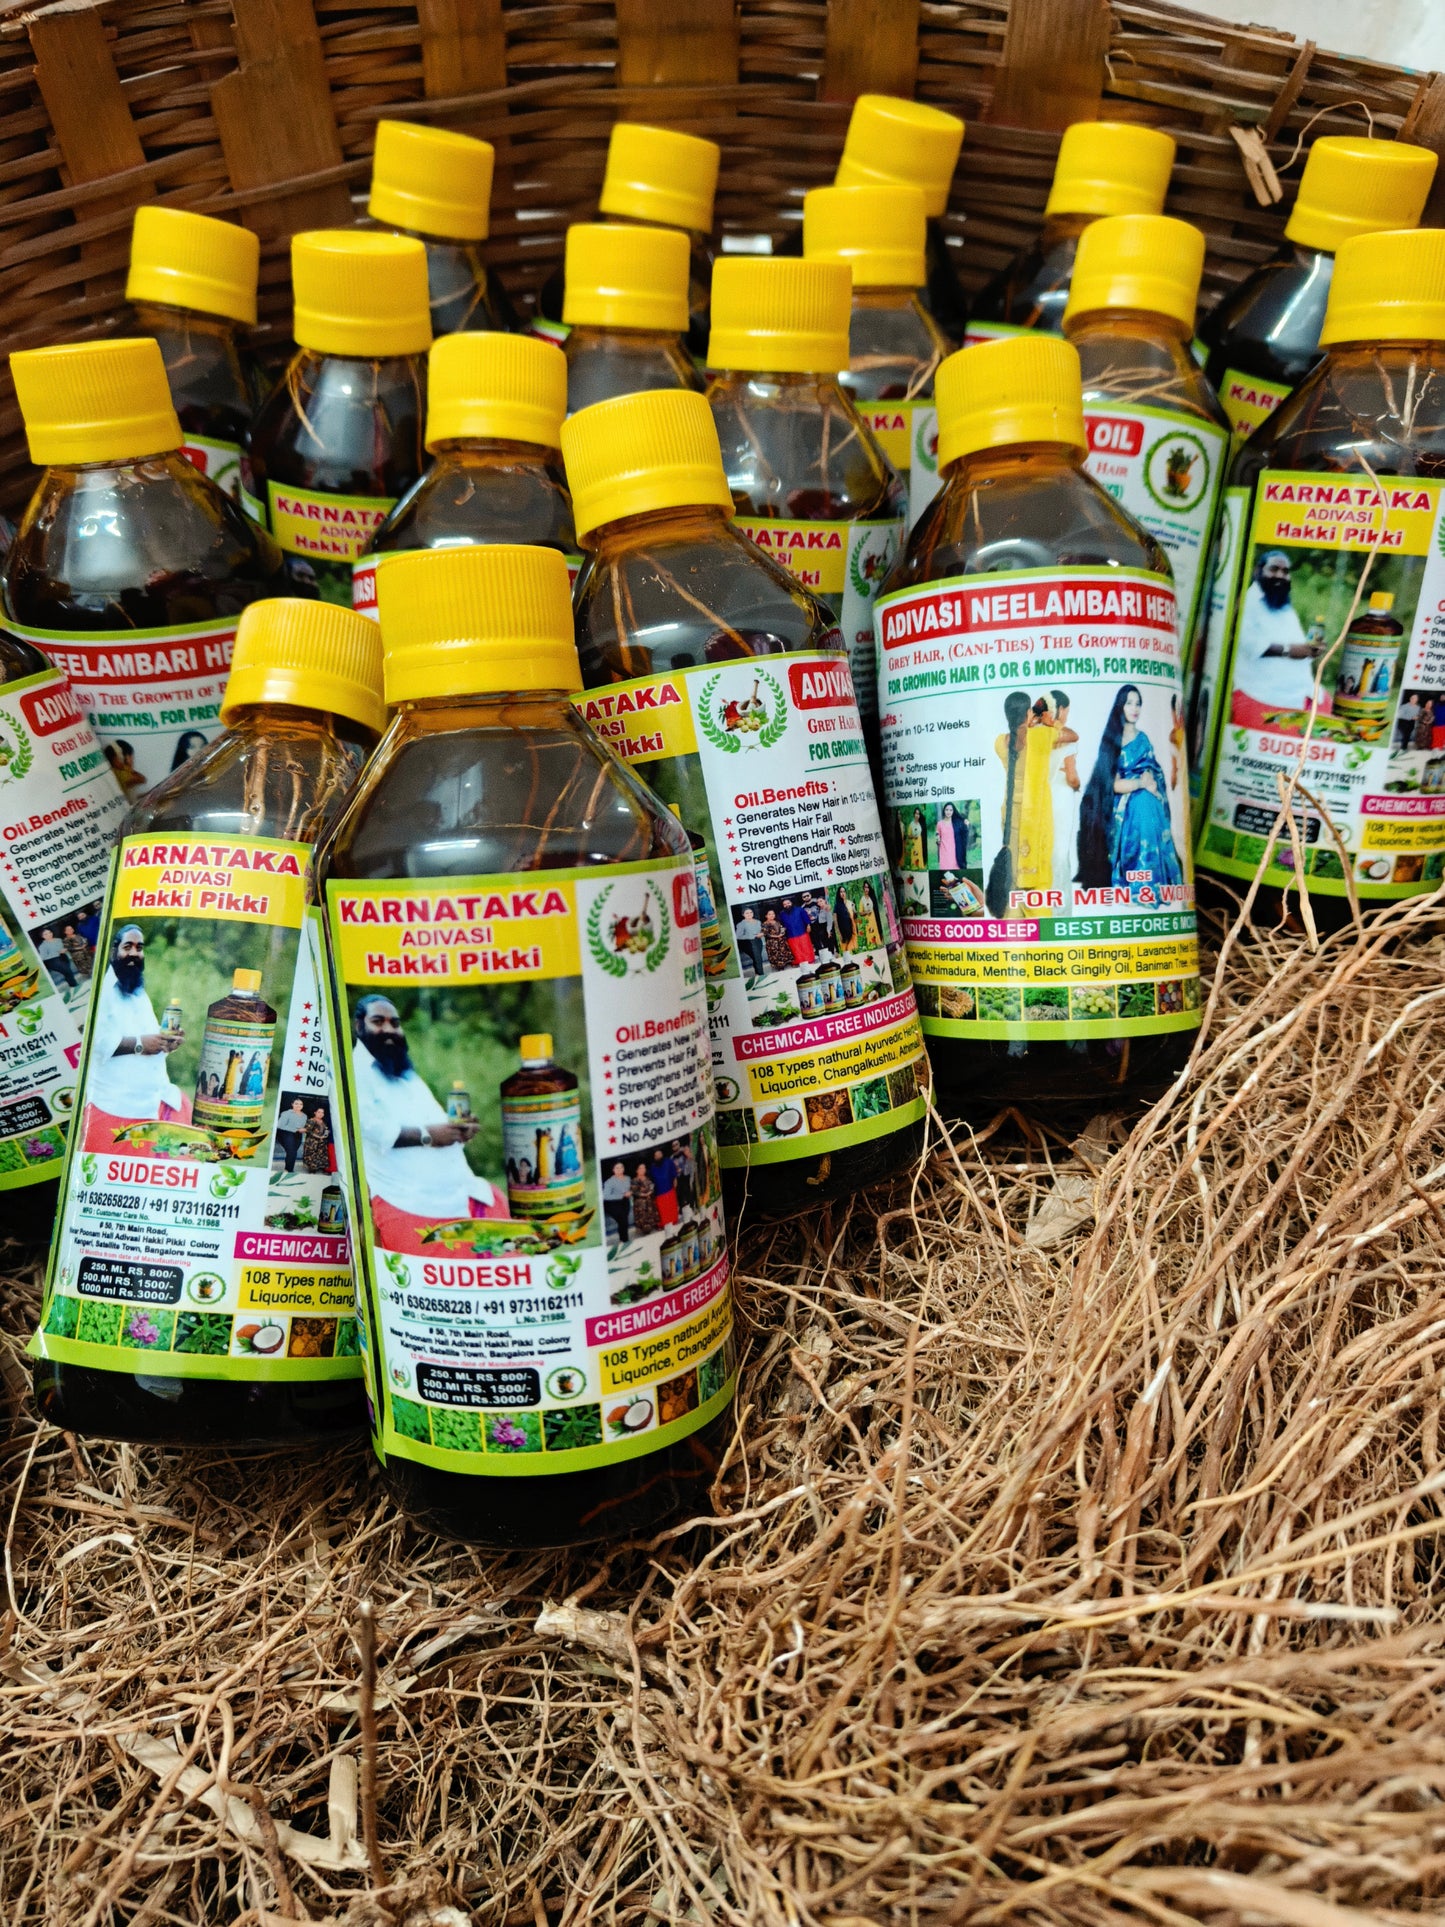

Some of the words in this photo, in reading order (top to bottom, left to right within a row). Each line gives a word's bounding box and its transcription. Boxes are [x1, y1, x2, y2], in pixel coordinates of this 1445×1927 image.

[1094, 423, 1134, 450] OIL
[1265, 484, 1431, 510] KARNATAKA
[277, 497, 386, 526] KARNATA
[1306, 509, 1373, 523] ADIVASI
[320, 525, 372, 541] ADIVAS
[1276, 523, 1336, 541] Hakki
[1344, 528, 1403, 546] Pikki
[295, 536, 348, 554] Hakki
[887, 600, 962, 641] ADIVASI
[972, 590, 1141, 624] NEELAMBARI
[888, 679, 901, 695] FOR
[903, 670, 946, 690] GROWING
[950, 666, 980, 683] HAIR
[1000, 661, 1018, 678] OR
[1023, 661, 1031, 676] 6
[1035, 657, 1100, 678] MONTHS),
[1104, 658, 1126, 673] FOR
[161, 709, 186, 724] FOR
[913, 723, 934, 734] 10-12
[938, 720, 970, 730] Weeks
[809, 742, 830, 760] FOR
[59, 760, 81, 780] FOR
[906, 762, 937, 772] Softness
[940, 761, 960, 771] your
[964, 757, 985, 767] Hair
[734, 781, 828, 809] Oil.Benefits
[931, 786, 955, 795] Splits
[736, 806, 795, 824] Generates
[798, 801, 820, 813] New
[822, 796, 840, 808] Hair
[1366, 798, 1427, 813] CHEMICAL
[1430, 799, 1445, 812] FRE
[3, 797, 88, 840] Oil.Benefits
[739, 821, 789, 838] Prevents
[792, 816, 814, 828] Hair
[816, 812, 832, 824] Fall
[10, 828, 65, 854] Generates
[65, 818, 85, 829] New
[742, 829, 808, 852] Strengthens
[811, 826, 830, 838] Hair
[833, 822, 855, 834] Roots
[15, 843, 64, 867] Prevents
[65, 832, 83, 846] Hair
[124, 845, 300, 876] KARNATAKA
[744, 849, 788, 866] Prevent
[791, 840, 836, 858] Dandruff,
[22, 848, 84, 880] Strengthens
[746, 869, 764, 880] No
[767, 863, 792, 876] Side
[795, 856, 829, 871] Effects
[836, 863, 858, 877] Stops
[28, 869, 71, 892] Prevent
[34, 893, 51, 904] No
[54, 881, 78, 895] Side
[78, 864, 108, 883] Effects
[160, 870, 232, 887] ADIVASI
[748, 882, 766, 894] No
[769, 878, 791, 891] Age
[794, 872, 822, 885] Limit,
[1128, 871, 1151, 881] USE
[40, 905, 57, 916] No
[60, 894, 80, 905] Age
[131, 890, 192, 907] Hakki
[201, 892, 268, 914] Pikki
[340, 891, 567, 924] KARNATAKA
[1010, 890, 1062, 908] FOR
[1074, 888, 1130, 905] MEN
[1139, 887, 1155, 902] &
[1161, 886, 1194, 901] WOM
[401, 926, 492, 946] ADIVASI
[945, 924, 984, 938] GOOD
[988, 923, 1037, 937] SLEEP
[1055, 921, 1104, 936] BEST
[1110, 918, 1169, 934] BEFORE
[368, 953, 447, 974] Hakki
[461, 948, 540, 971] Pikki
[934, 951, 963, 961] Herbal
[966, 952, 999, 961] Mixed
[1003, 950, 1063, 963] Tenhoring
[1068, 949, 1084, 960] Oil
[1088, 948, 1134, 960] Bringraj,
[1137, 944, 1176, 956] Lavancha
[926, 965, 979, 978] Athimadura,
[983, 966, 1029, 978] Menthe,
[1034, 966, 1067, 976] Black
[1071, 965, 1111, 976] Gingily
[616, 1010, 695, 1043] Oil.Benefits
[741, 1028, 824, 1055] CHEMICAL
[826, 1015, 862, 1042] FREE
[863, 1001, 905, 1026] INDUCES
[616, 1041, 671, 1061] Generates
[617, 1060, 666, 1078] Prevents
[751, 1066, 774, 1080] 108
[777, 1059, 815, 1076] Types
[818, 1048, 862, 1066] nathural
[619, 1070, 680, 1095] Strengthens
[760, 1076, 820, 1095] Liquorice,
[620, 1096, 663, 1111] Prevent
[621, 1116, 638, 1128] No
[642, 1108, 665, 1122] Side
[622, 1132, 639, 1144] No
[642, 1126, 663, 1140] Age
[108, 1161, 199, 1188] SUDESH
[89, 1192, 140, 1209] 6362658228
[149, 1198, 168, 1212] +91
[172, 1200, 240, 1218] 9731162111
[190, 1240, 219, 1250] Colony
[243, 1237, 333, 1258] CHEMICAL
[138, 1280, 174, 1289] 1500/-
[149, 1269, 176, 1278] 800/-
[246, 1271, 270, 1284] 108
[275, 1273, 315, 1288] Types
[319, 1276, 352, 1287] nathu
[423, 1264, 532, 1286] SUDESH
[81, 1283, 100, 1292] 1000
[250, 1289, 315, 1305] Liquorice,
[408, 1295, 472, 1314] 6362658228
[484, 1301, 505, 1314] +91
[510, 1292, 583, 1313] 9731162111
[594, 1299, 680, 1339] CHEMICAL
[684, 1283, 710, 1310] FREE
[539, 1337, 570, 1346] Colony
[604, 1351, 628, 1367] 108
[632, 1339, 670, 1361] Types
[674, 1314, 709, 1345] nathural
[455, 1372, 472, 1380] ML
[612, 1357, 674, 1384] Liquorice,
[423, 1390, 449, 1401] 1000
[490, 1384, 531, 1393] 1500/-
